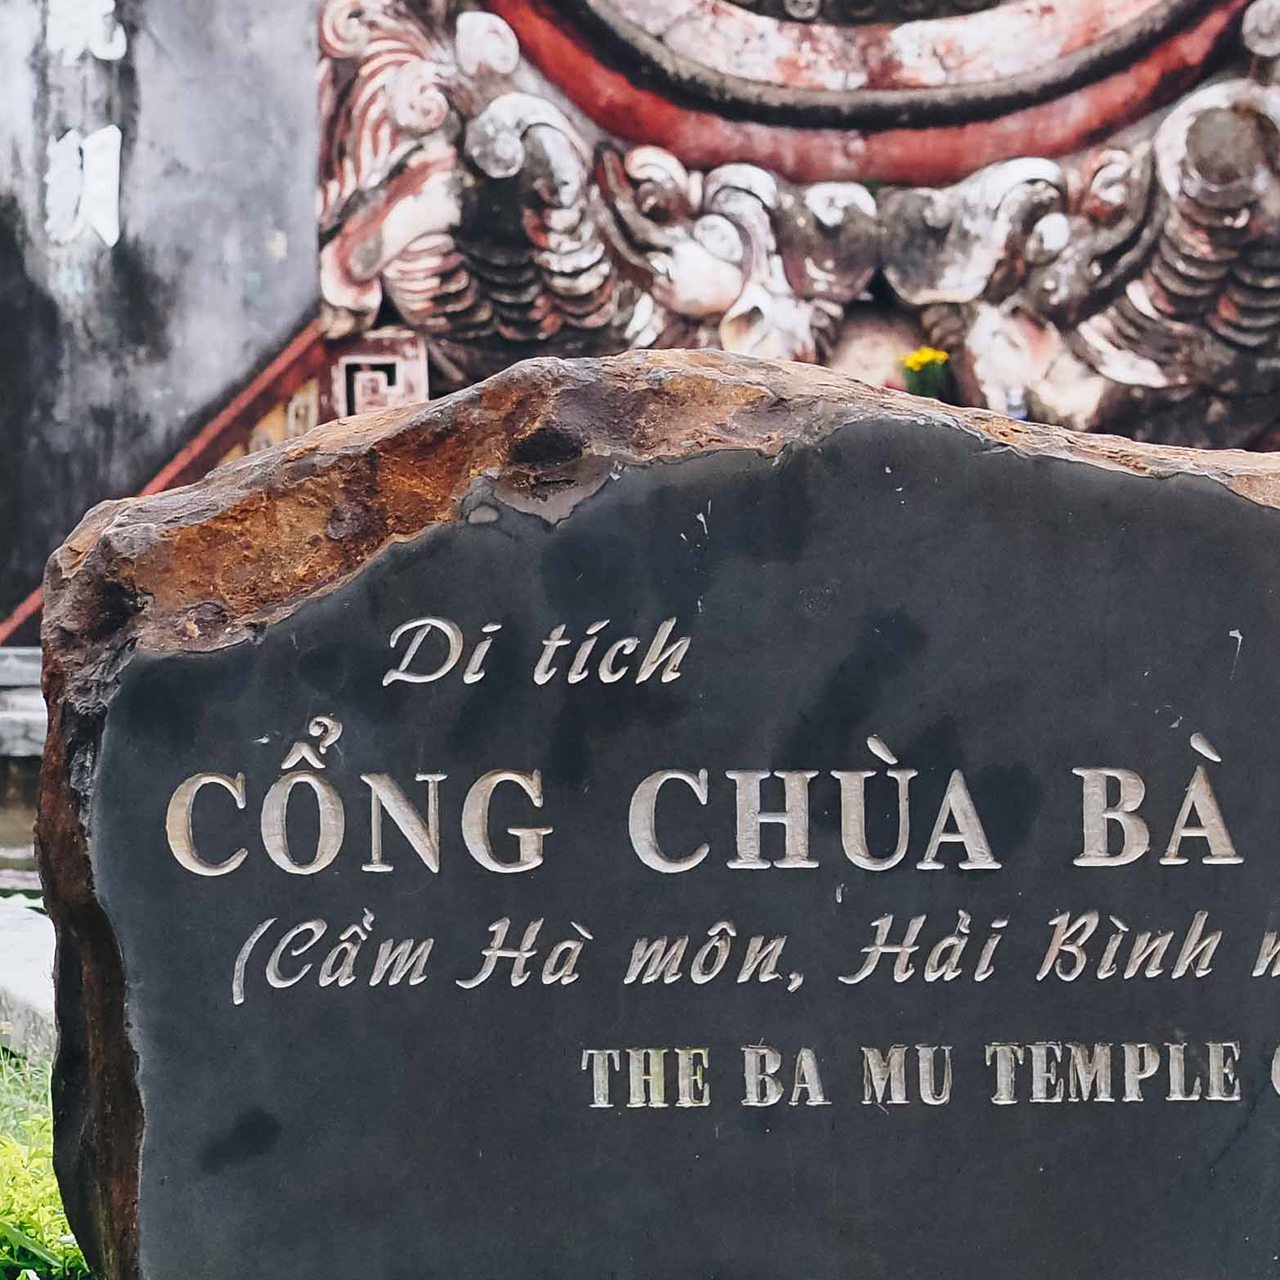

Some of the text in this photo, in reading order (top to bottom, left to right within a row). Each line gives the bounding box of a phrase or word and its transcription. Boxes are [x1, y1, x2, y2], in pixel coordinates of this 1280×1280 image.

[382, 616, 693, 686] Di tích
[164, 714, 554, 878] CỔNG
[628, 732, 1003, 875] CHÙA
[1071, 731, 1245, 869] BÀ
[455, 917, 596, 990] Hà
[623, 921, 807, 994] môn,
[838, 908, 1010, 986] Hải
[1035, 908, 1223, 983] Bình
[581, 1046, 713, 1111] THE
[740, 1044, 832, 1109] BA
[861, 1044, 953, 1108] MU
[984, 1039, 1243, 1106] TEMPLE
